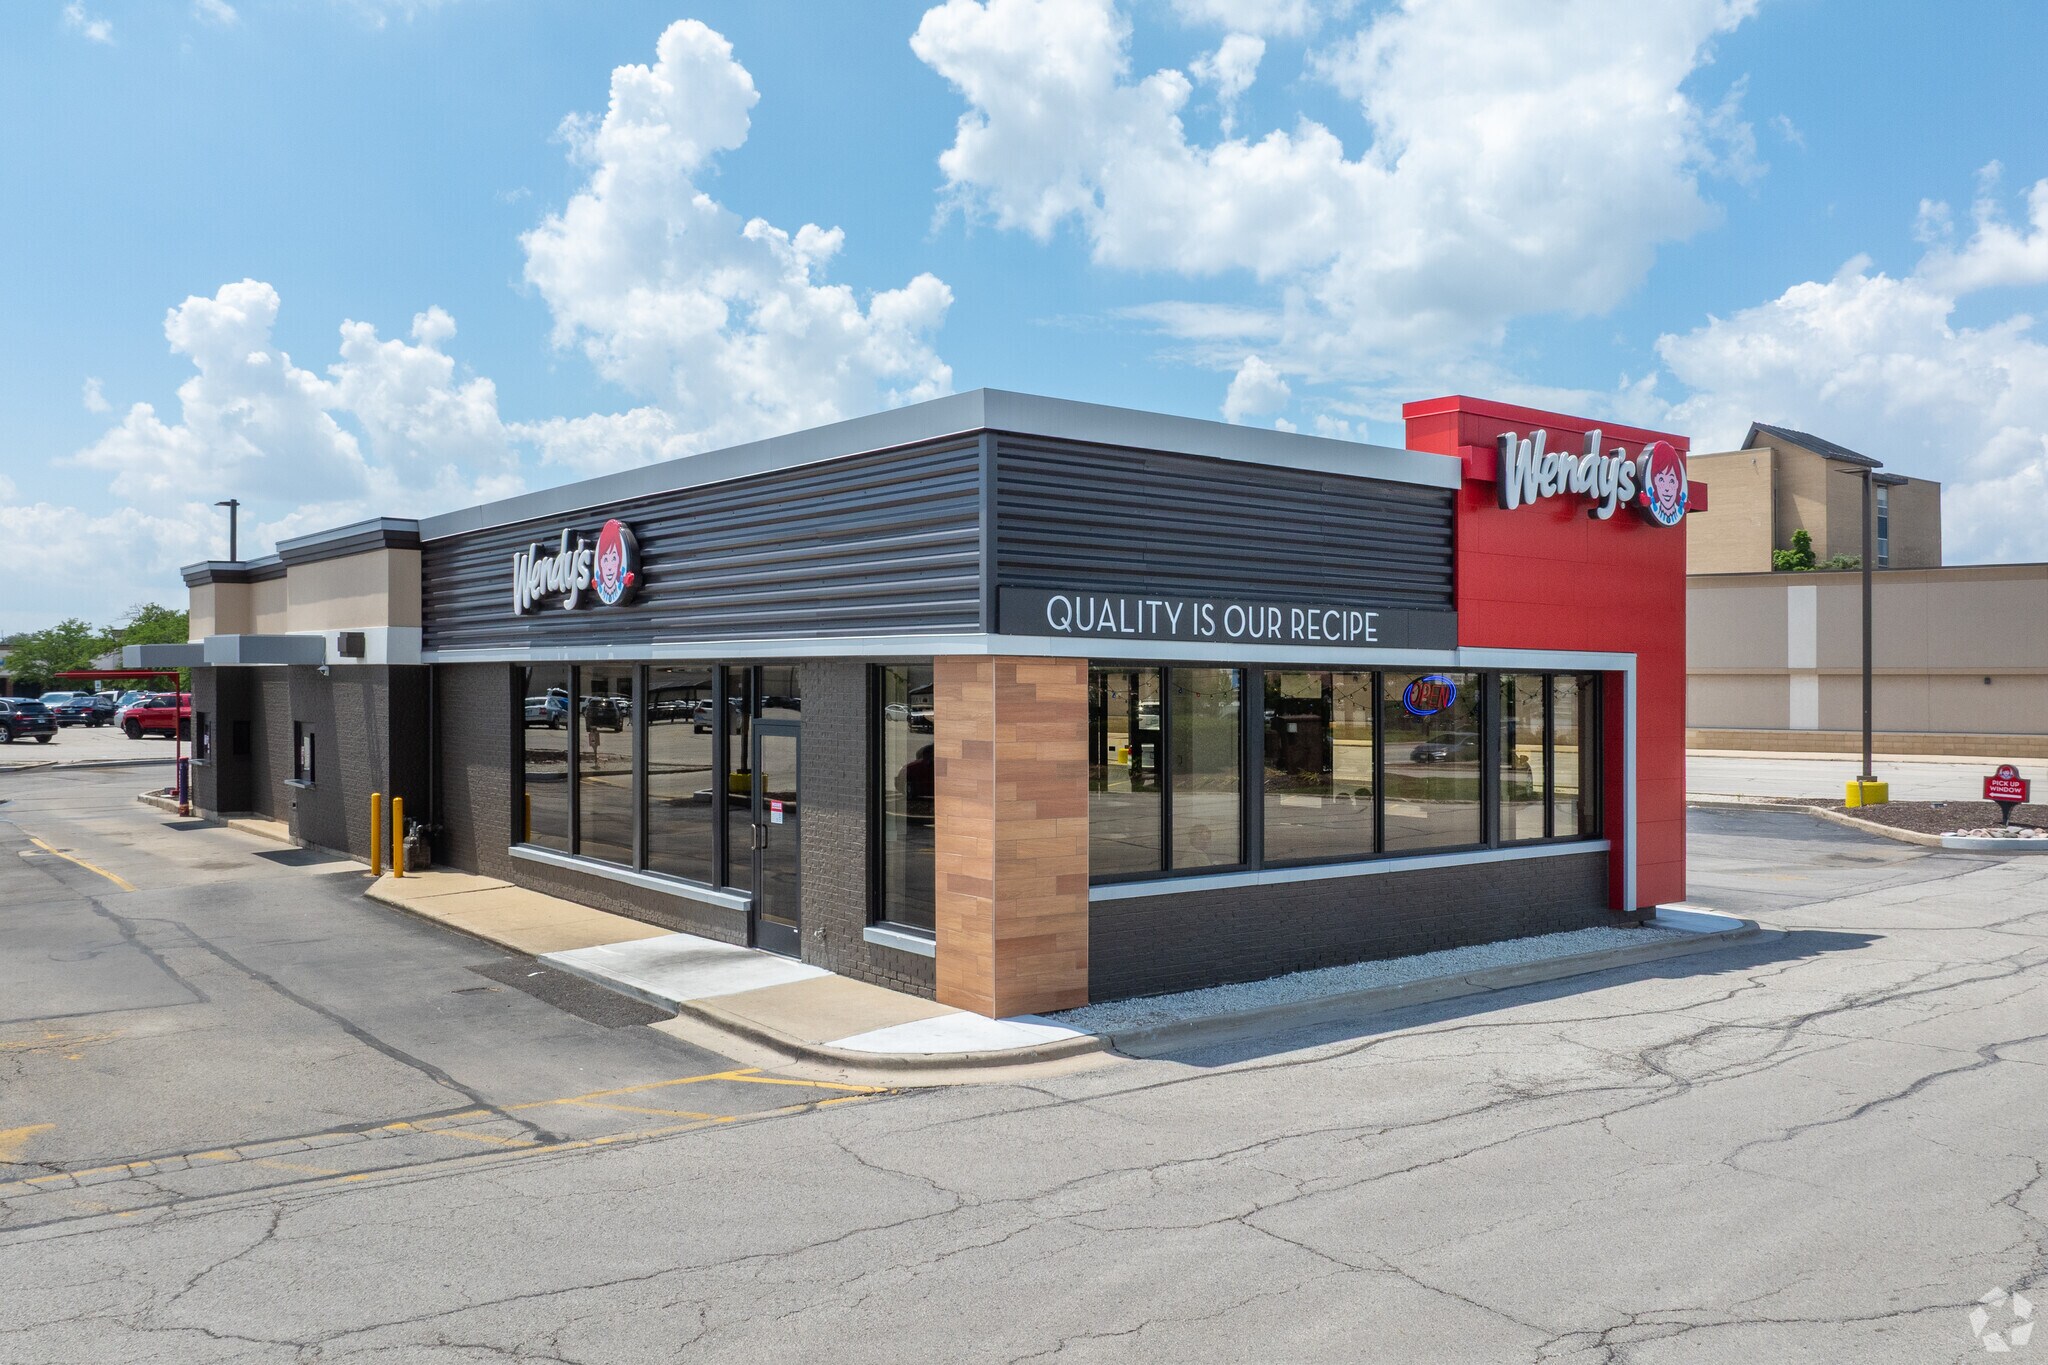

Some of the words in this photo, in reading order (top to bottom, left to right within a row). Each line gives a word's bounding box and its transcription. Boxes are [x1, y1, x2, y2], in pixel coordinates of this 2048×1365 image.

[1500, 428, 1636, 520] Wendy's
[513, 528, 591, 616] Wendy's
[1046, 595, 1184, 634] QUALITY
[1193, 603, 1216, 637] IS
[1223, 604, 1282, 639] OUR
[1291, 608, 1379, 642] RECIPE
[1410, 681, 1450, 709] OPEN
